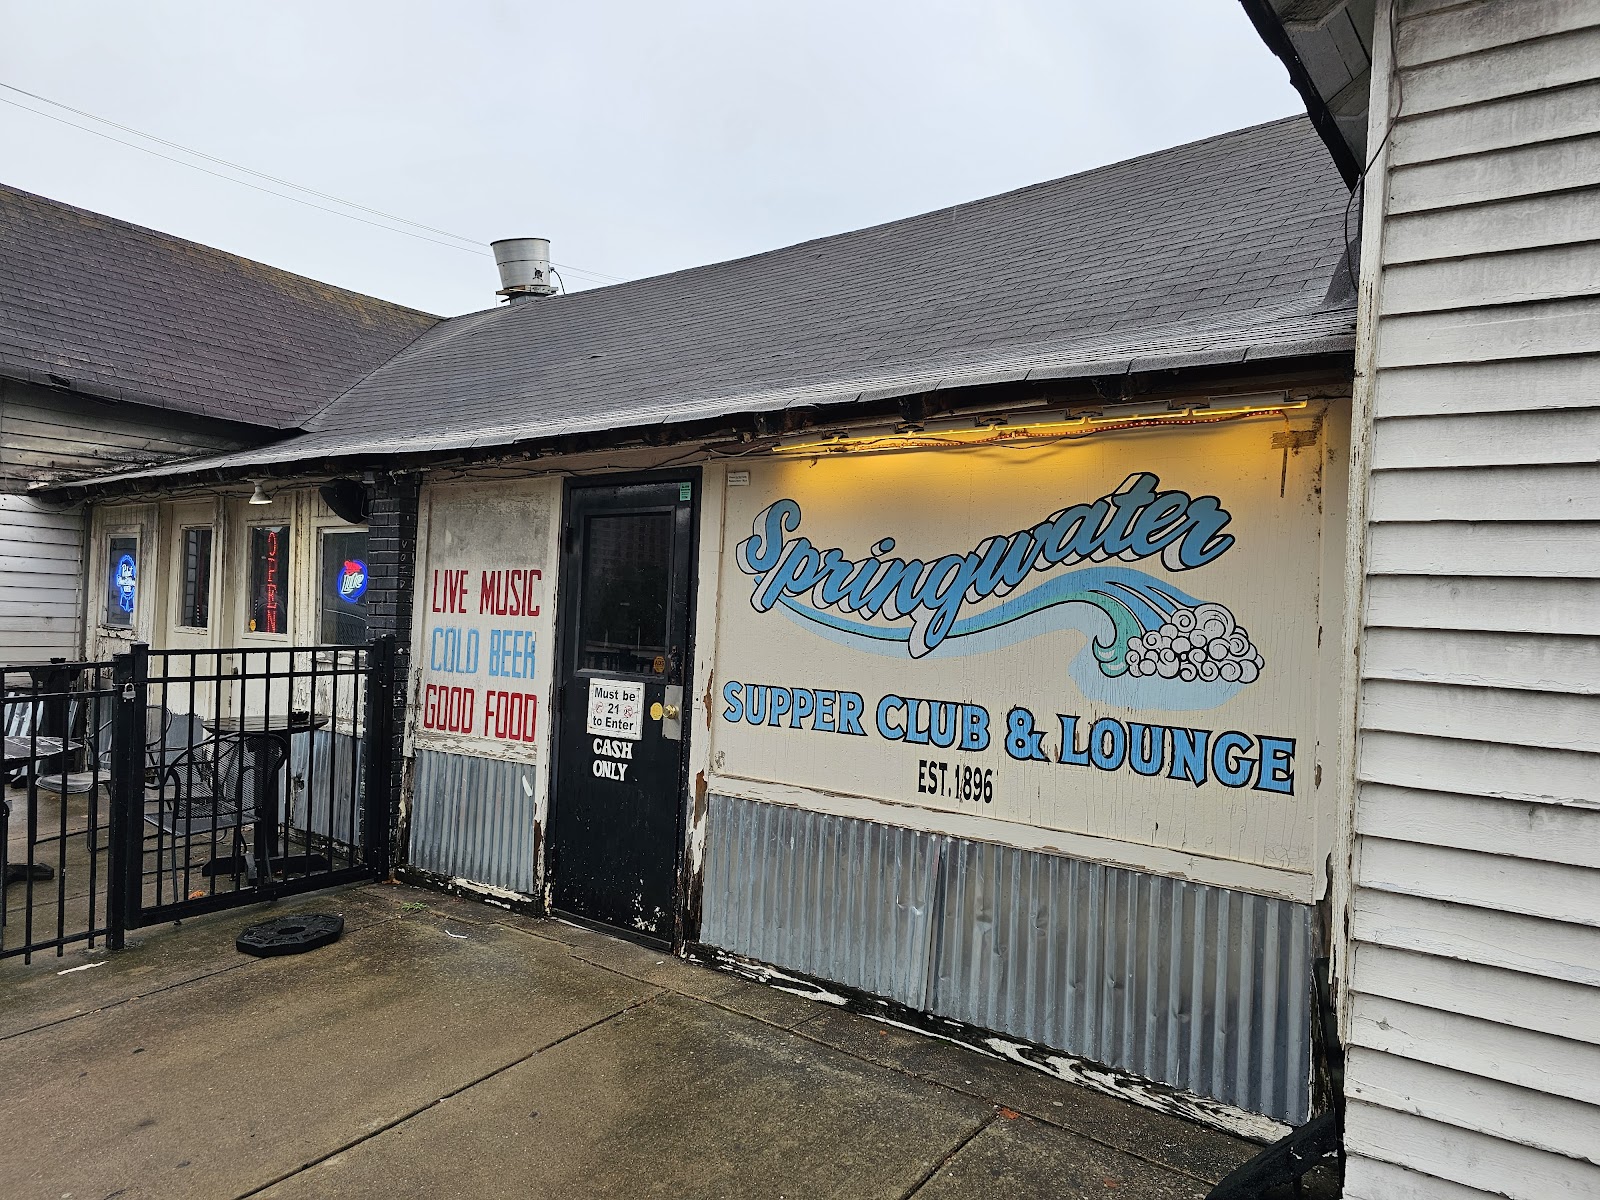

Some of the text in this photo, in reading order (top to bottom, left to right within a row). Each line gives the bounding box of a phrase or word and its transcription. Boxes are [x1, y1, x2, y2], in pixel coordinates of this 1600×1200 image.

[736, 471, 1235, 659] Springwater
[432, 569, 542, 617] LIVE MUSIC
[430, 626, 537, 680] COLD BEER
[594, 687, 636, 702] Must be
[607, 703, 620, 715] 21
[423, 683, 537, 743] GOOD FOOD
[592, 715, 634, 731] to Enter
[592, 737, 633, 760] CASH
[722, 680, 1297, 797] SUPPER CLUB & LOUNGE
[592, 759, 629, 782] ONLY
